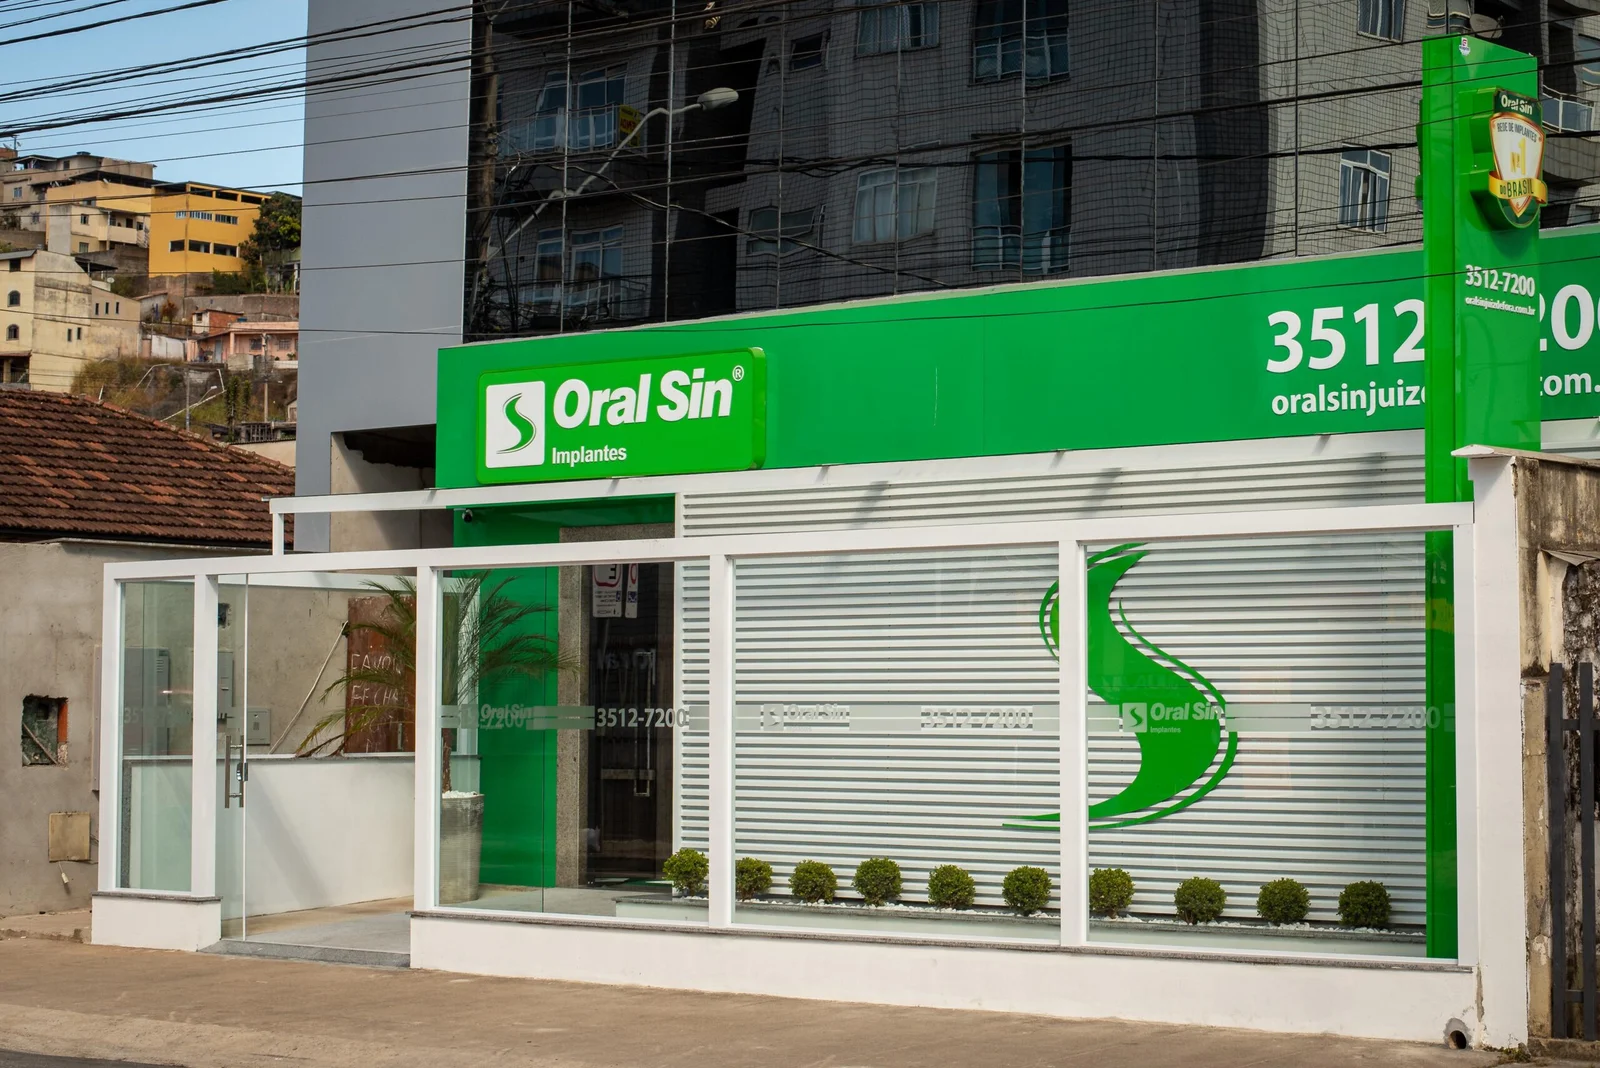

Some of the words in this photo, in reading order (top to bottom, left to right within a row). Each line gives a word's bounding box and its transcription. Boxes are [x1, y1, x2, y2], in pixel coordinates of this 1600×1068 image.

[1501, 95, 1519, 111] Oral
[1520, 101, 1533, 115] Sin
[1514, 124, 1538, 142] IMPLANTES
[1507, 179, 1534, 197] BRASIL
[1465, 264, 1536, 297] 3512-7200
[553, 373, 652, 429] Oral
[552, 445, 627, 467] Implantes
[596, 708, 687, 728] 3512-7200
[787, 704, 819, 720] Oral
[822, 703, 847, 720] Sin
[923, 707, 1030, 729] 3512-7200
[1150, 703, 1189, 721] Oral
[1192, 702, 1222, 721] Sin
[1315, 706, 1441, 729] 3512-7200
[1150, 726, 1181, 734] Implantes
